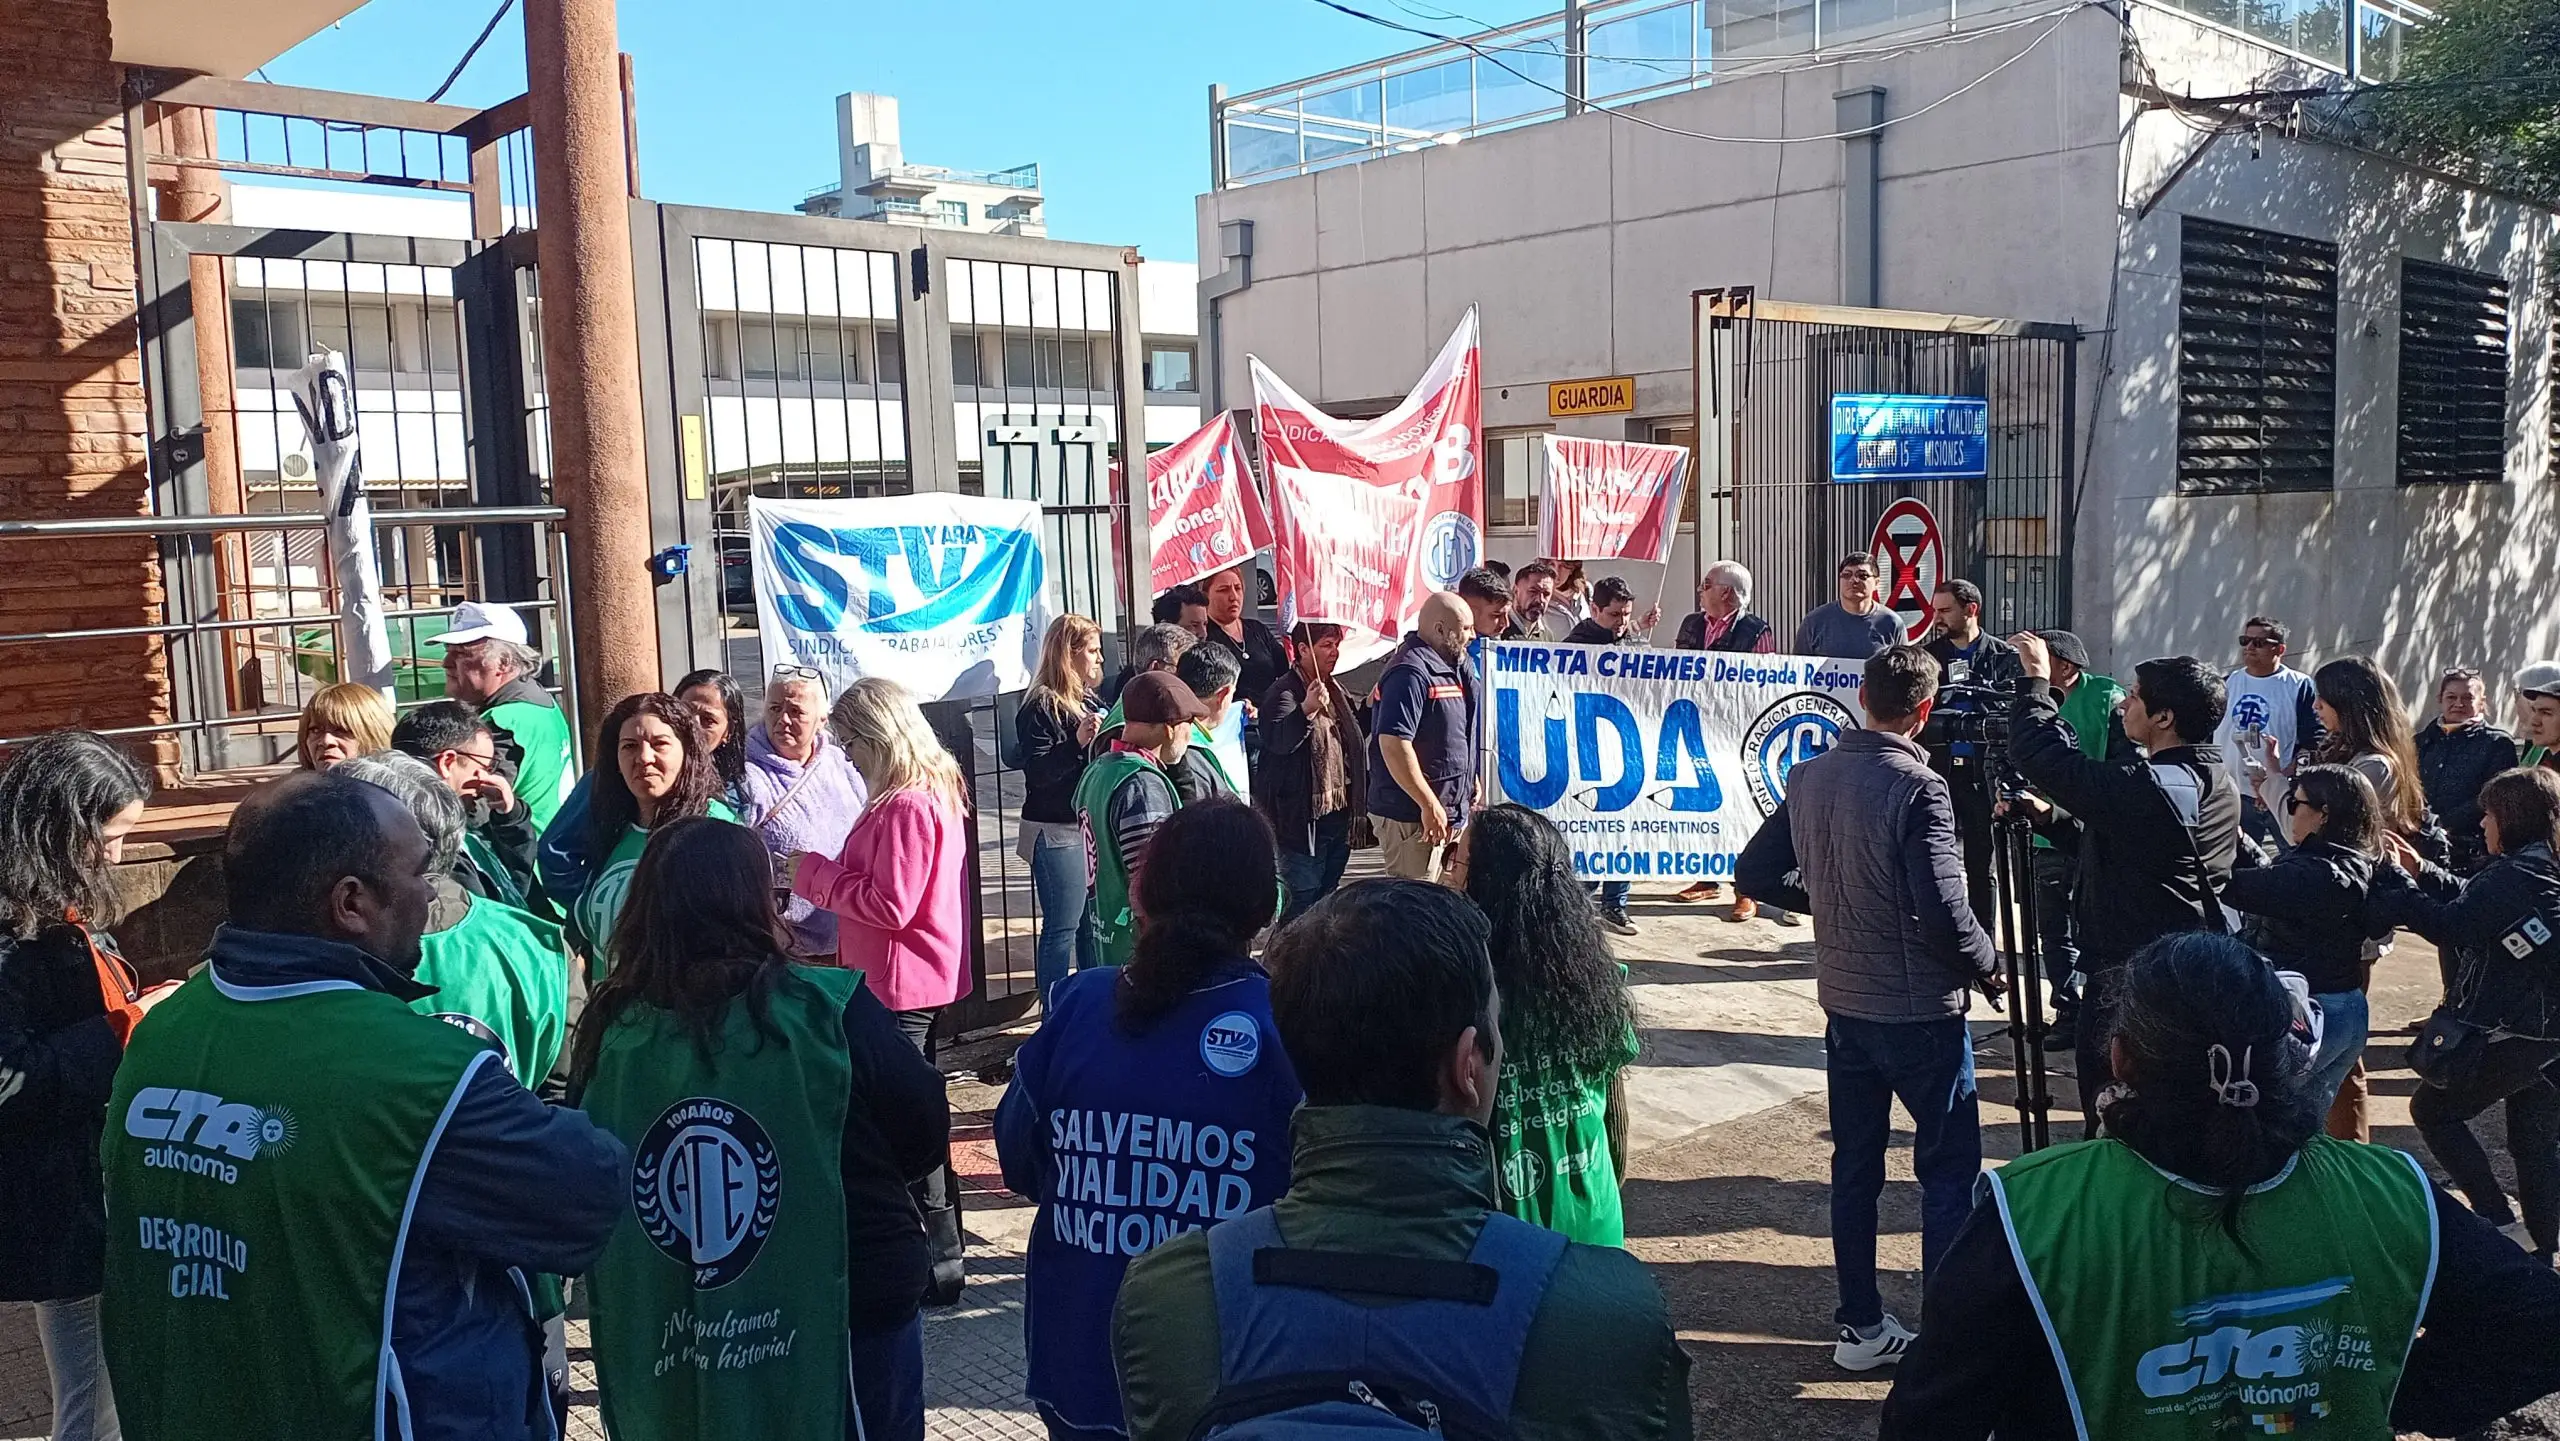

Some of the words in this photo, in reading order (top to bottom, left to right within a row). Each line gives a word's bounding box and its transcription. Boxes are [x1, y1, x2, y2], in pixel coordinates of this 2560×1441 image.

[1557, 384, 1625, 410] GUARDIA
[1933, 409, 1945, 434] DE
[1947, 407, 1985, 436] VIALIDAD
[1857, 440, 1897, 468] DISTRITO
[1900, 440, 1909, 467] 15
[1924, 440, 1964, 466] MISIONES
[924, 525, 936, 546] Y
[941, 525, 978, 546] ARA
[774, 522, 968, 632] STV
[1496, 646, 1588, 675] MIRTA
[1597, 654, 1707, 681] CHEMES
[1714, 658, 1798, 686] Delegada
[1496, 688, 1723, 812] UDA
[1631, 820, 1720, 834] ARGENTINOS
[1573, 846, 1651, 877] ACIÓN
[1657, 851, 1738, 876] REGION
[1207, 1028, 1246, 1046] STV
[1519, 1085, 1545, 1103] lxs
[125, 1087, 258, 1161] CTA
[1500, 1122, 1518, 1138] se
[1050, 1109, 1256, 1171] SALVEMOS
[1054, 1153, 1252, 1220] VIALIDAD
[1053, 1204, 1202, 1257] NACION
[170, 1263, 229, 1301] CIAL
[654, 1353, 675, 1377] en
[717, 1329, 797, 1371] historia!
[2337, 1334, 2372, 1354] Bue
[2136, 1326, 2306, 1399] CTA
[2332, 1352, 2377, 1372] Aire
[2238, 1381, 2320, 1406] utónoma
